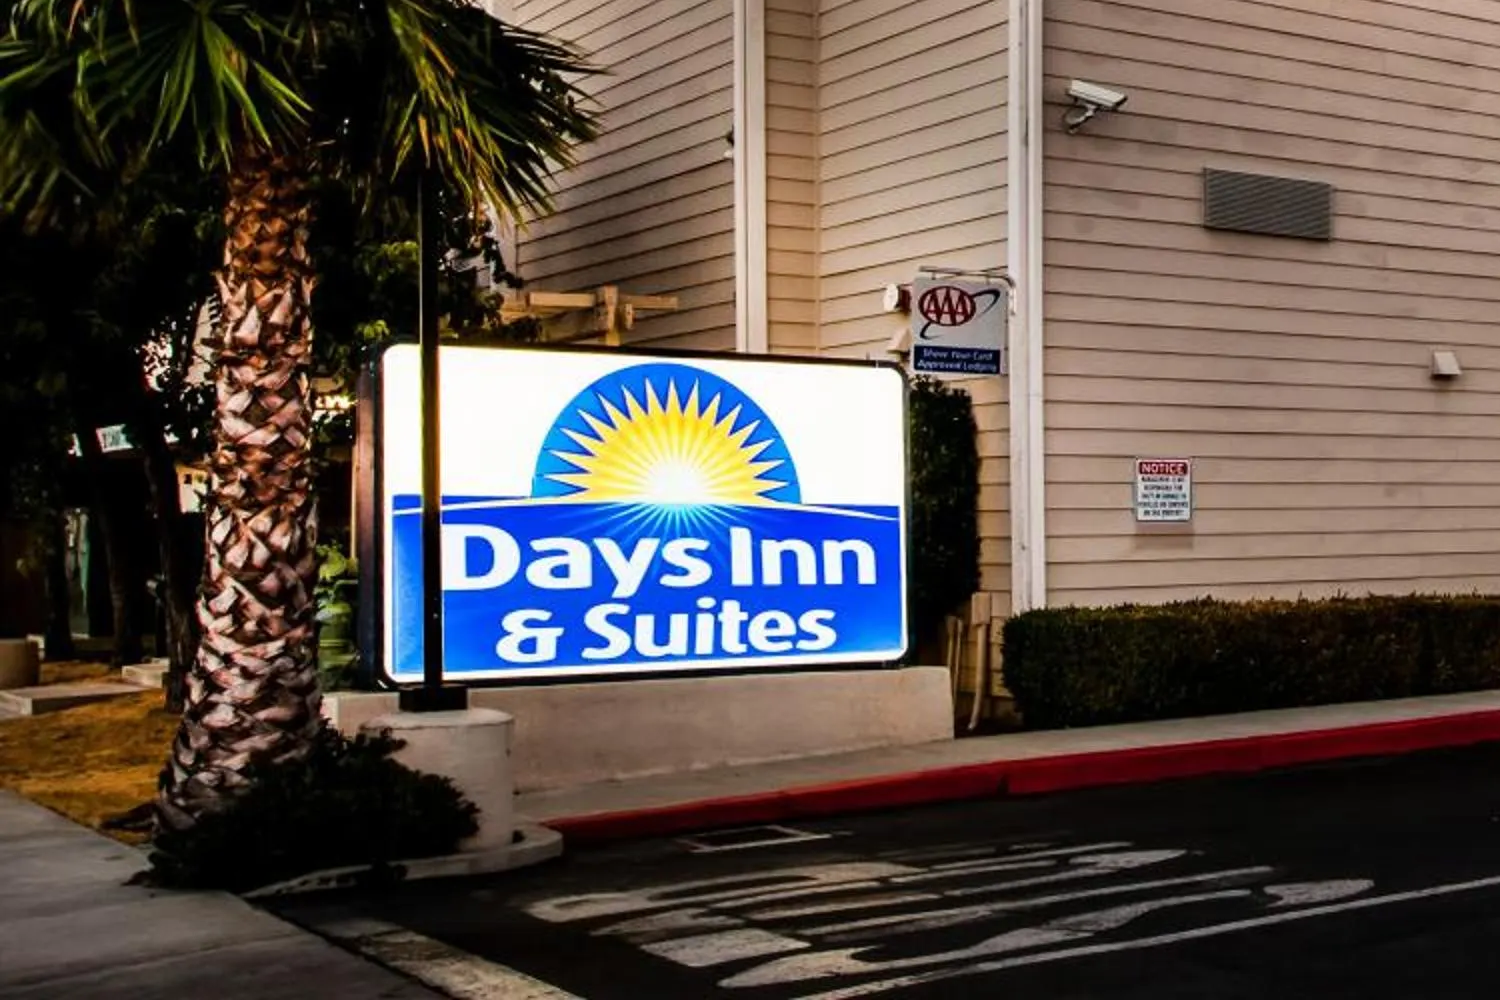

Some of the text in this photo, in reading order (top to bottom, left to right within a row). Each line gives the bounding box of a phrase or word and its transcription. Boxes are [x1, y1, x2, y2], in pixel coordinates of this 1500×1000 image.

[923, 287, 971, 325] AAA
[1141, 463, 1185, 473] NOTICE
[442, 523, 877, 598] Days Inn
[495, 598, 837, 663] & Suites
